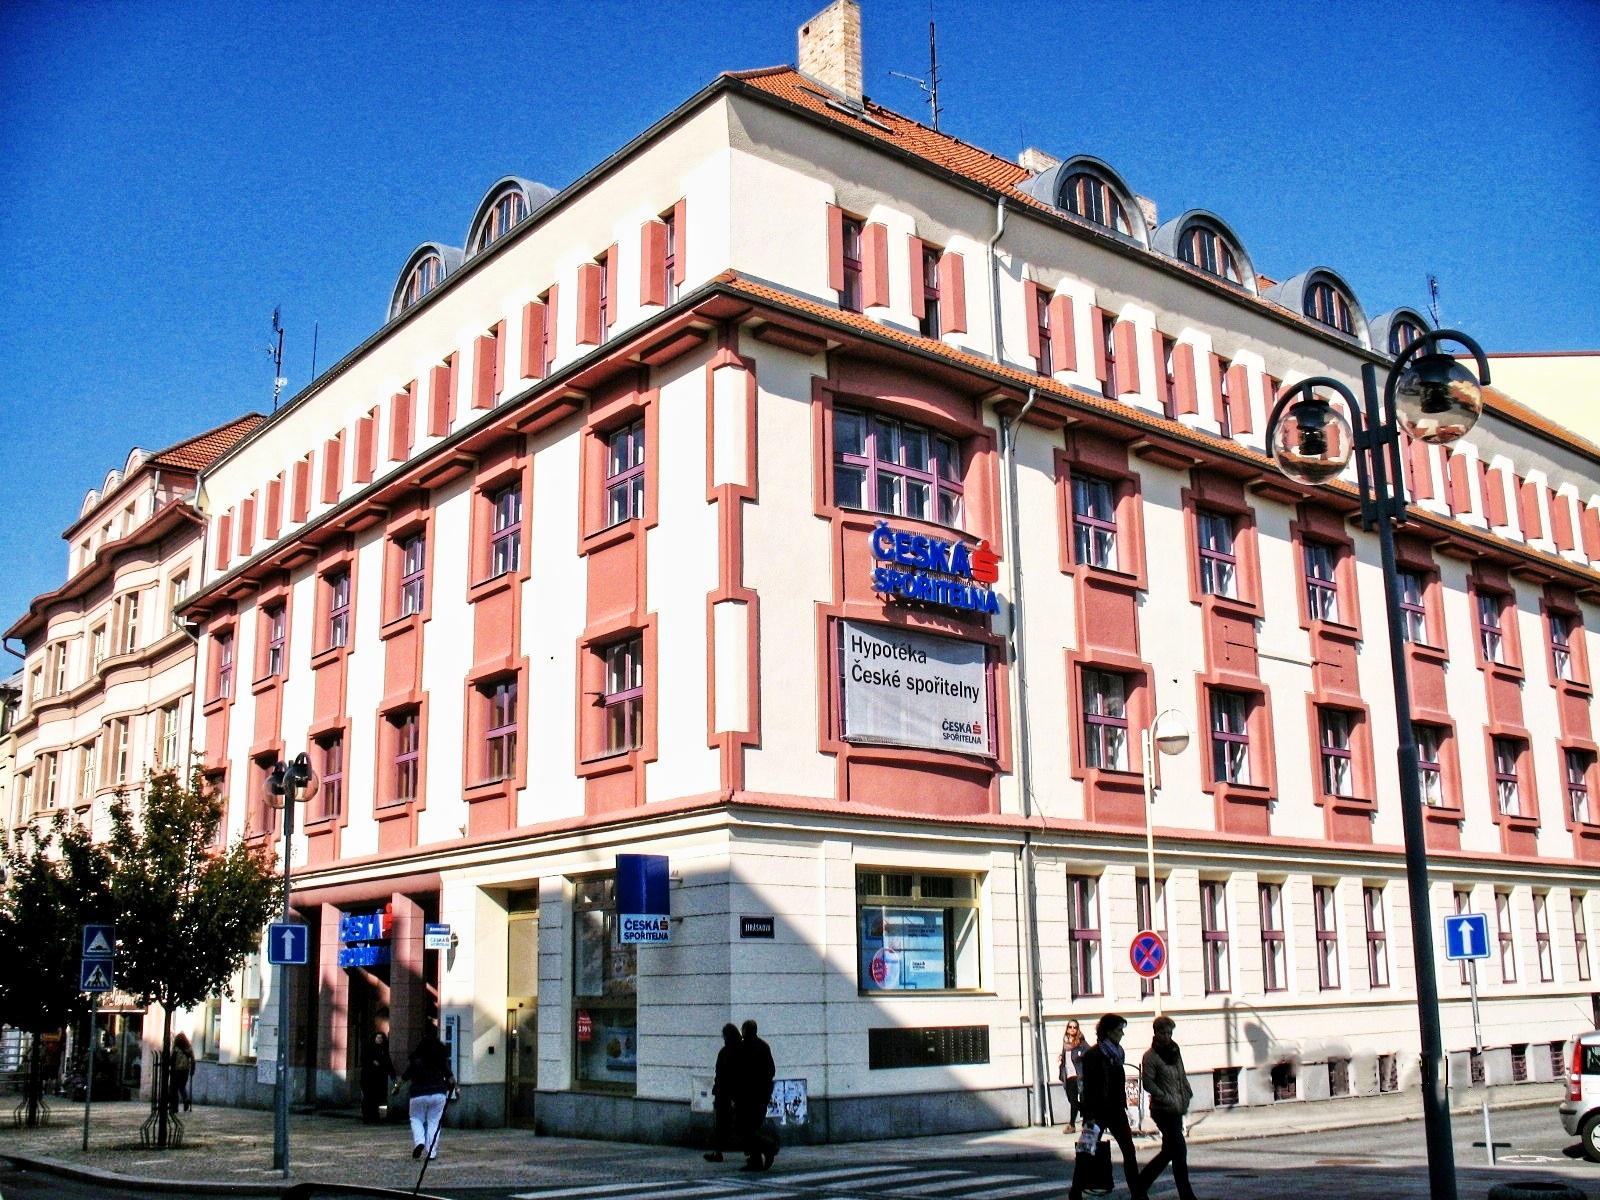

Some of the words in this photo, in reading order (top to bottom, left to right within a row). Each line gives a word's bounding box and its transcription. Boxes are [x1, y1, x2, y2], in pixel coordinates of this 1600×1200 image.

[868, 520, 972, 579] ČESKÁ
[871, 567, 1000, 615] SPOŘITELNA
[851, 634, 927, 664] Hypotéka
[851, 658, 901, 688] České
[906, 675, 980, 704] spořitelny
[941, 718, 972, 734] ČESKÁ
[942, 732, 982, 744] SPOŘITELNA
[623, 931, 669, 940] SPOŘITELNA
[624, 918, 660, 930] ČESKÁ
